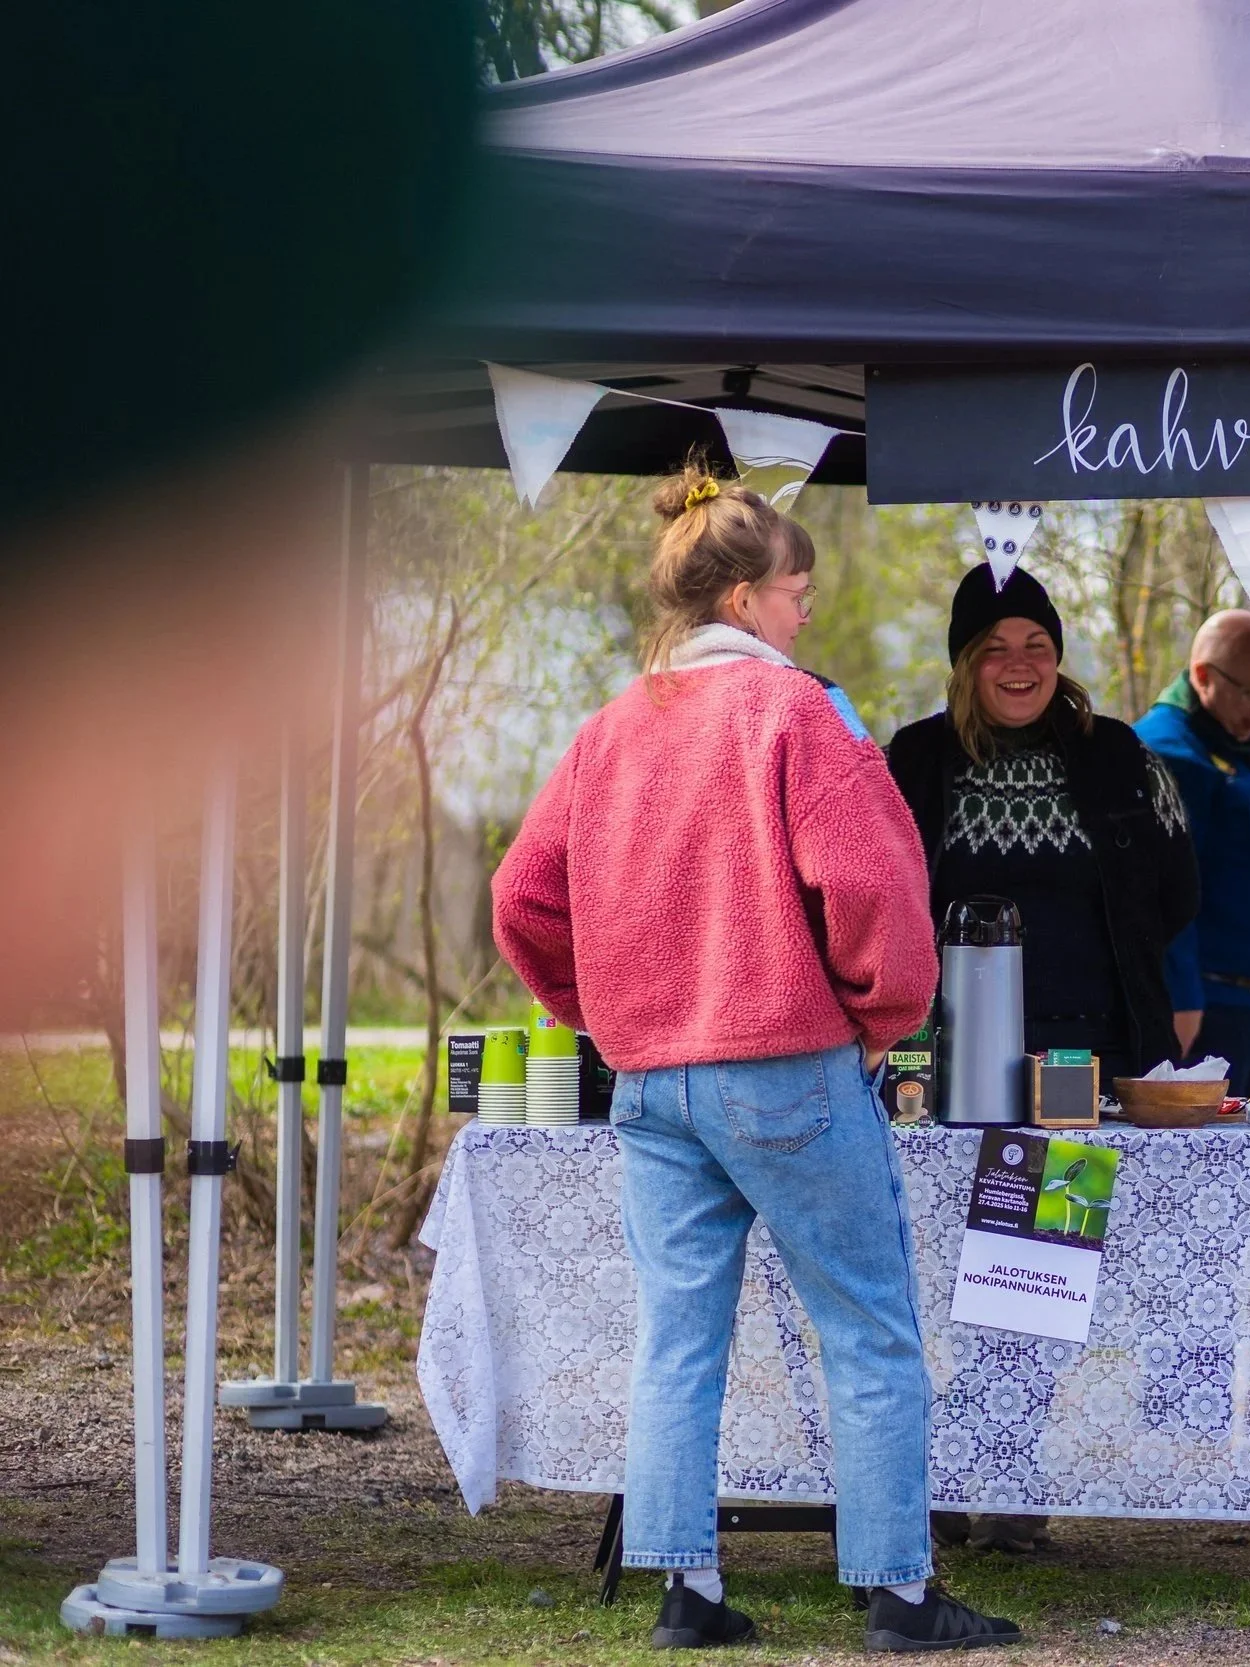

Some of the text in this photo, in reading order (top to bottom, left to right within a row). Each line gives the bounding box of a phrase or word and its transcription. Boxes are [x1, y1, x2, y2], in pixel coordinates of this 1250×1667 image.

[450, 1040, 480, 1049] Tomaatti
[892, 1053, 927, 1063] BARISTA
[985, 1167, 1028, 1182] Jalotuksen
[978, 1177, 1036, 1192] KEVÄTTAPAHTUMA
[978, 1193, 1029, 1206] Keravan kartanolla
[978, 1199, 1004, 1208] 27.4.2025
[1013, 1205, 1028, 1213] 11-16
[981, 1218, 1019, 1229] www.jalotus.fi
[988, 1264, 1068, 1286] JALOTUKSEN
[963, 1273, 1087, 1303] NOKIPANNUKAHVILA
